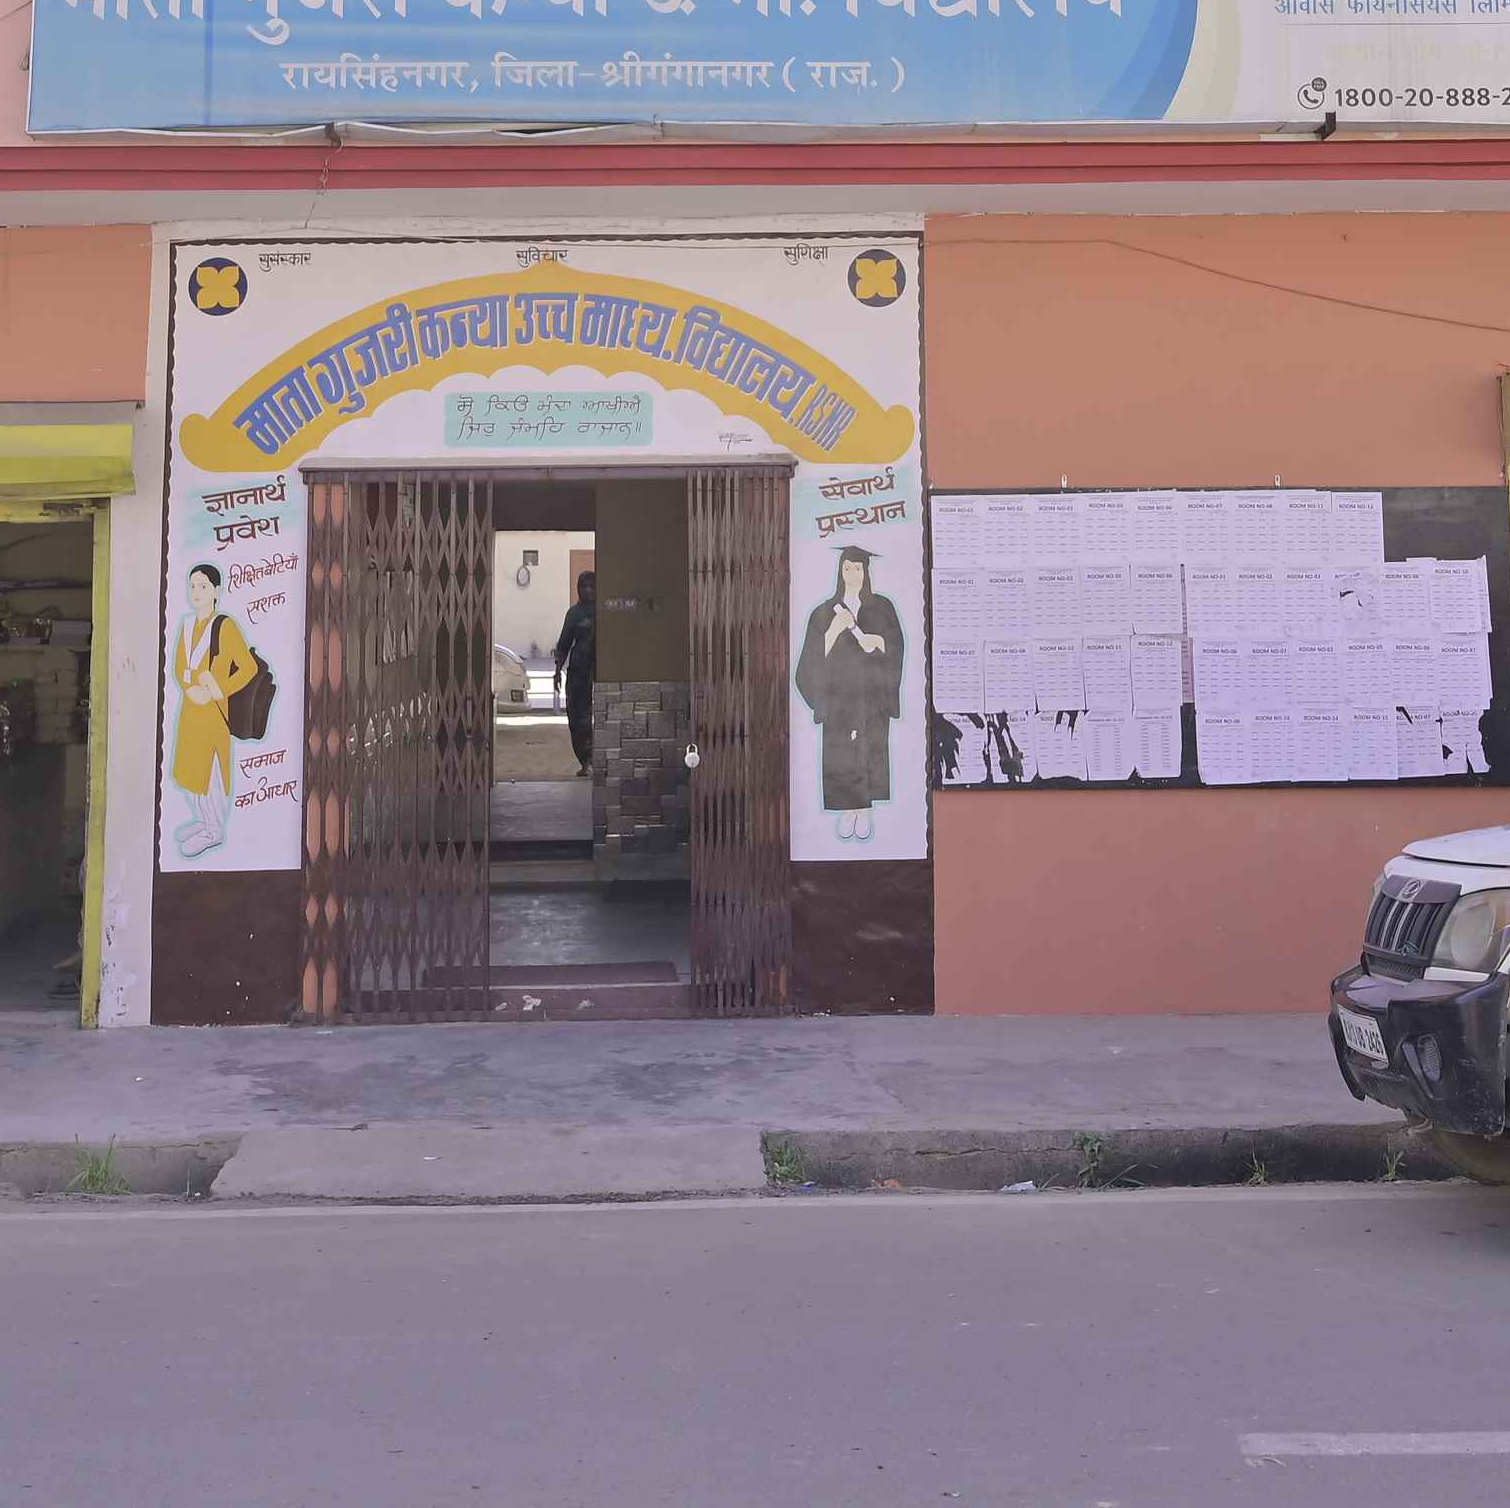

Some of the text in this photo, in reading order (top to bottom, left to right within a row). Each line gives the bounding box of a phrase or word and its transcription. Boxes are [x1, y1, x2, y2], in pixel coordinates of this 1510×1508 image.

[278, 52, 479, 92] रायसिंहनगर,
[515, 247, 569, 268] सुविचार
[233, 365, 324, 455] माता
[306, 302, 420, 418] गुजरी
[414, 294, 511, 361] कन्या
[514, 292, 580, 347] उच्च
[202, 467, 897, 518] ज्ञानार्थ सेवार्थ
[213, 500, 907, 552] प्रवेश प्रस्थान
[239, 748, 288, 780] समाज
